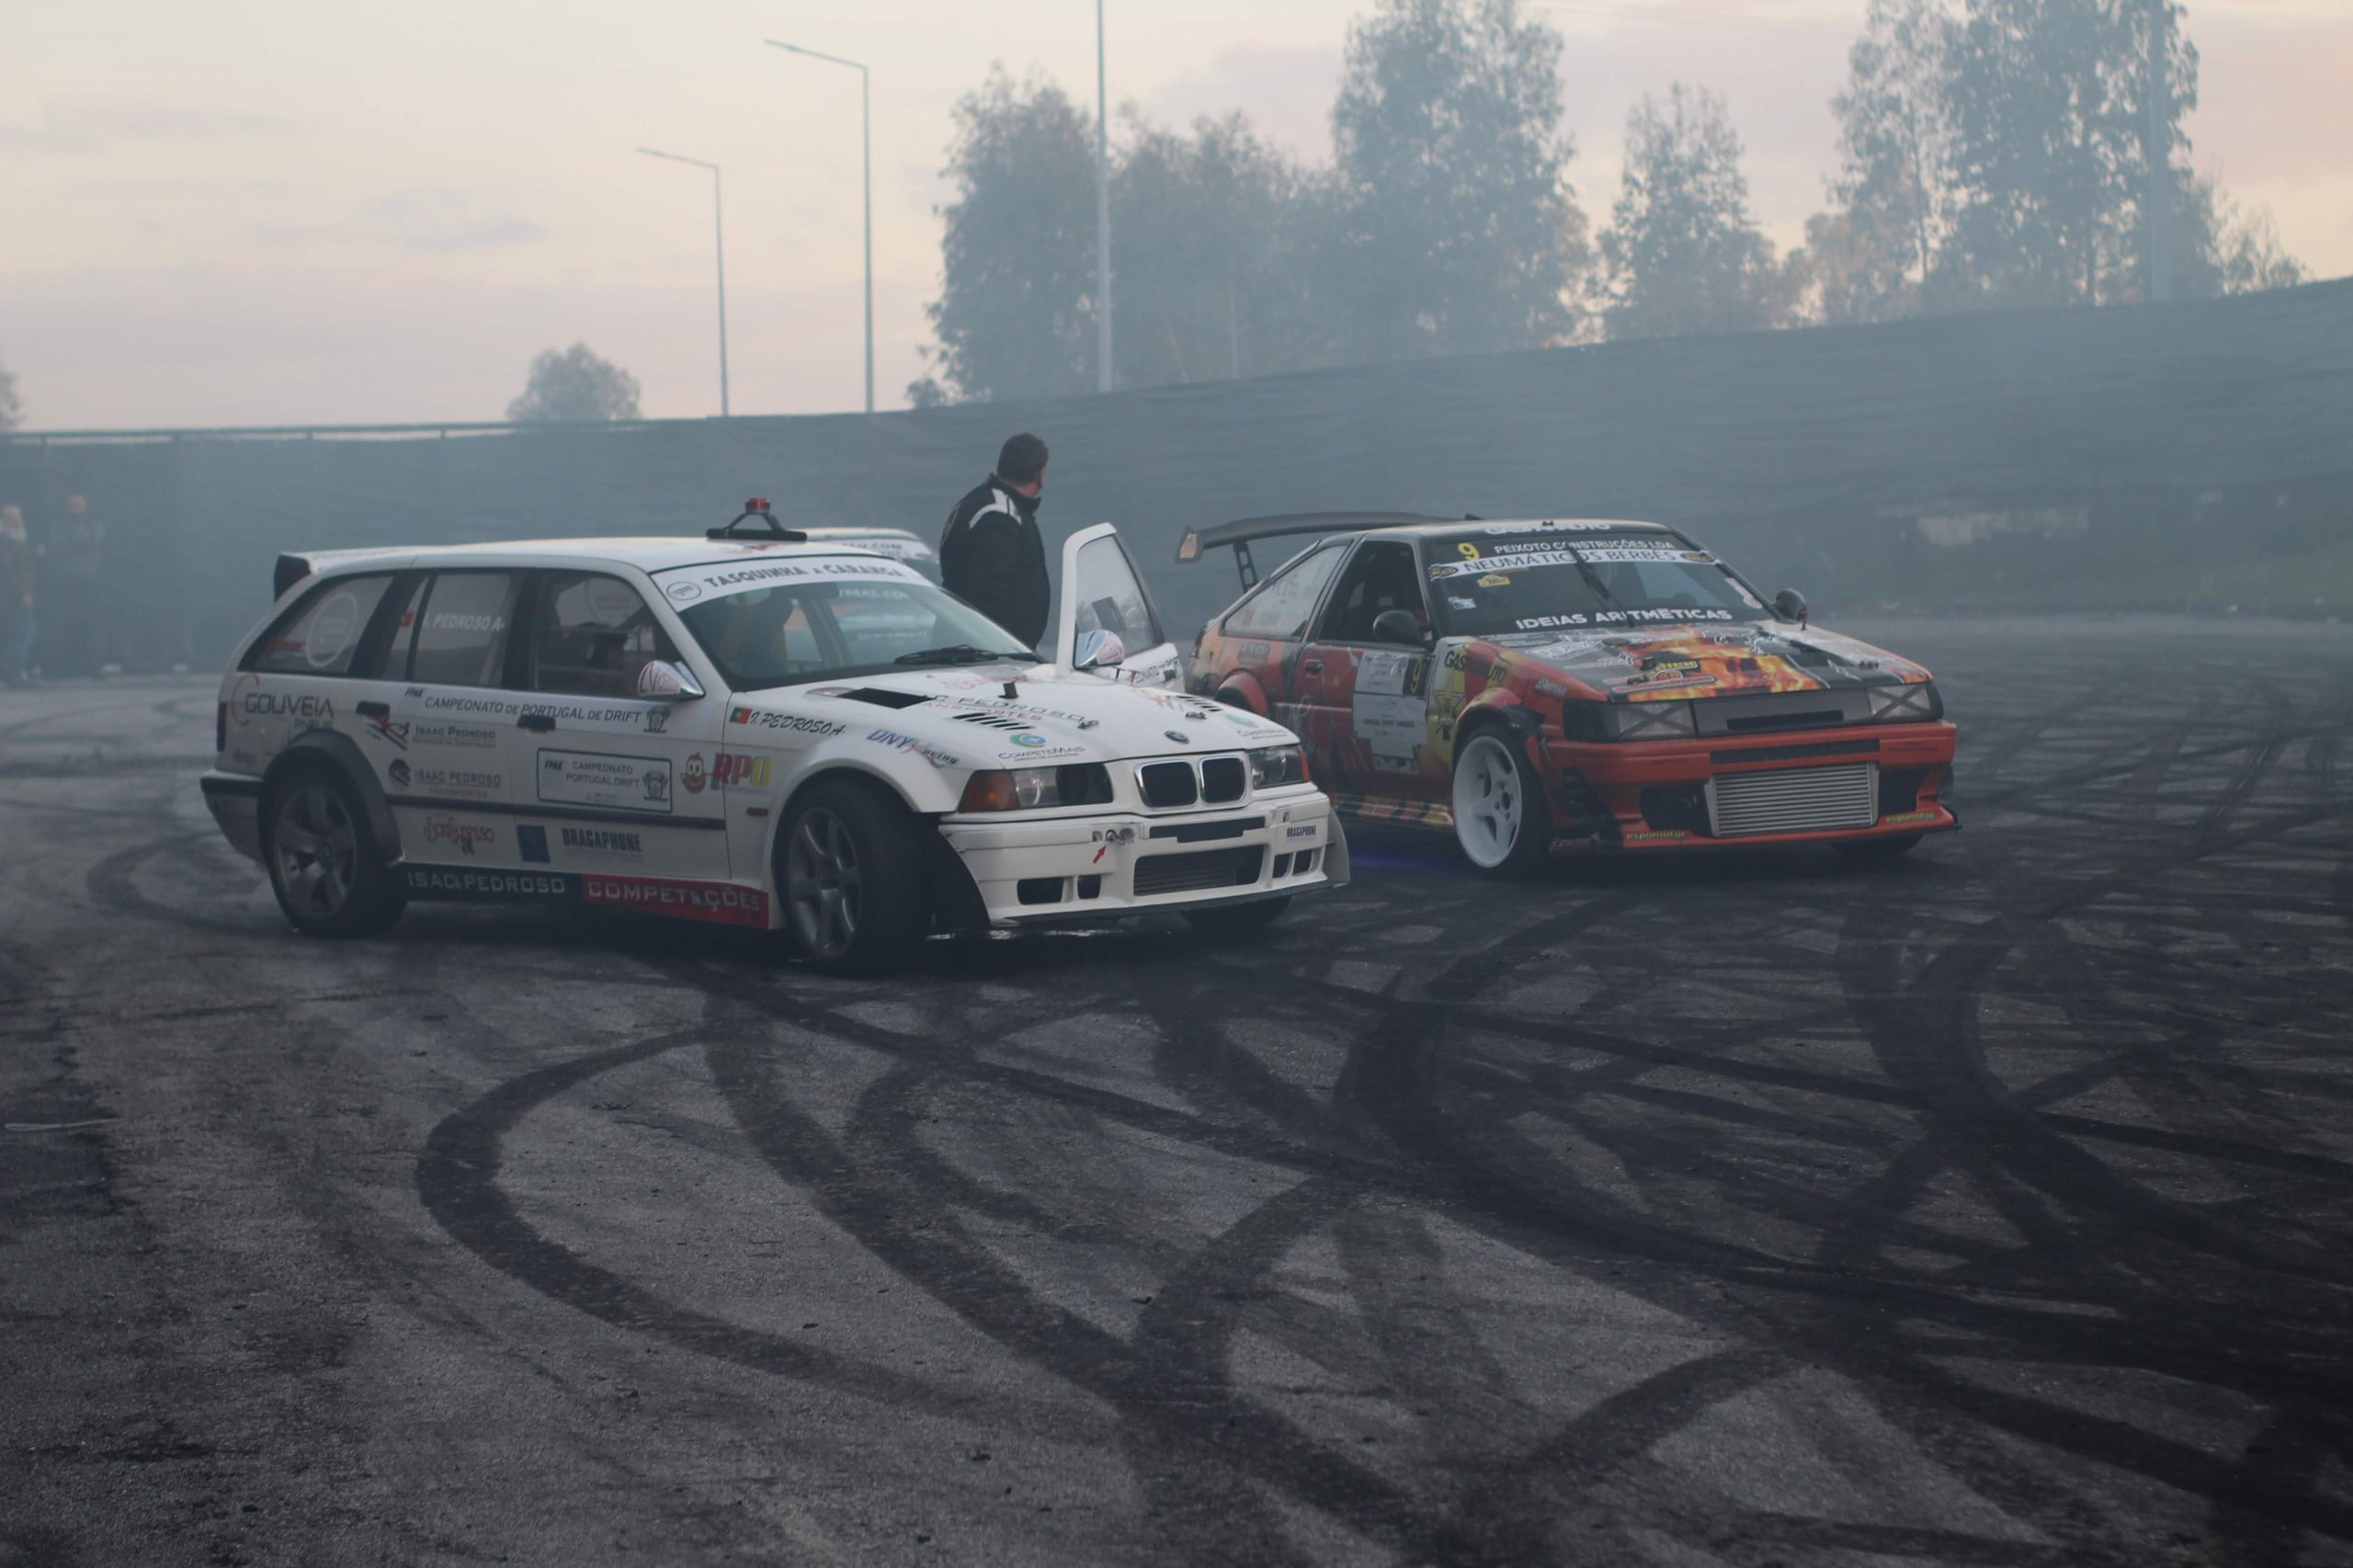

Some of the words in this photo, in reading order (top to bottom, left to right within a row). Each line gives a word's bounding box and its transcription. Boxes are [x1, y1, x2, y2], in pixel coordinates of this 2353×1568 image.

[1458, 542, 1482, 561] 9
[1494, 542, 1551, 554] PEIXOTO
[1648, 540, 1676, 550] LDA
[704, 565, 808, 588] TASQUINHA
[433, 613, 491, 631] PEDROSO
[1515, 613, 1588, 631] IDEIAS
[1410, 659, 1423, 694] 9
[244, 693, 334, 718] GOUVEIA
[425, 697, 504, 714] CAMPEONATO
[505, 704, 518, 715] DE
[520, 704, 585, 720] PORTUGAL
[587, 710, 603, 722] DE
[604, 710, 642, 723] DRIFT
[448, 726, 495, 739] PEDROSO
[758, 713, 832, 734] PEDROSO
[572, 761, 633, 774] CAMPEONATO
[711, 753, 772, 790] RPO
[415, 769, 446, 782] ISAAC
[449, 772, 501, 787] PEDROSO
[566, 773, 613, 786] PORTUGAL
[614, 778, 640, 788] DRIFT
[562, 827, 642, 853] BRAGAPHONE
[1626, 831, 1685, 841] expomotor
[464, 874, 565, 893] PEDROSO
